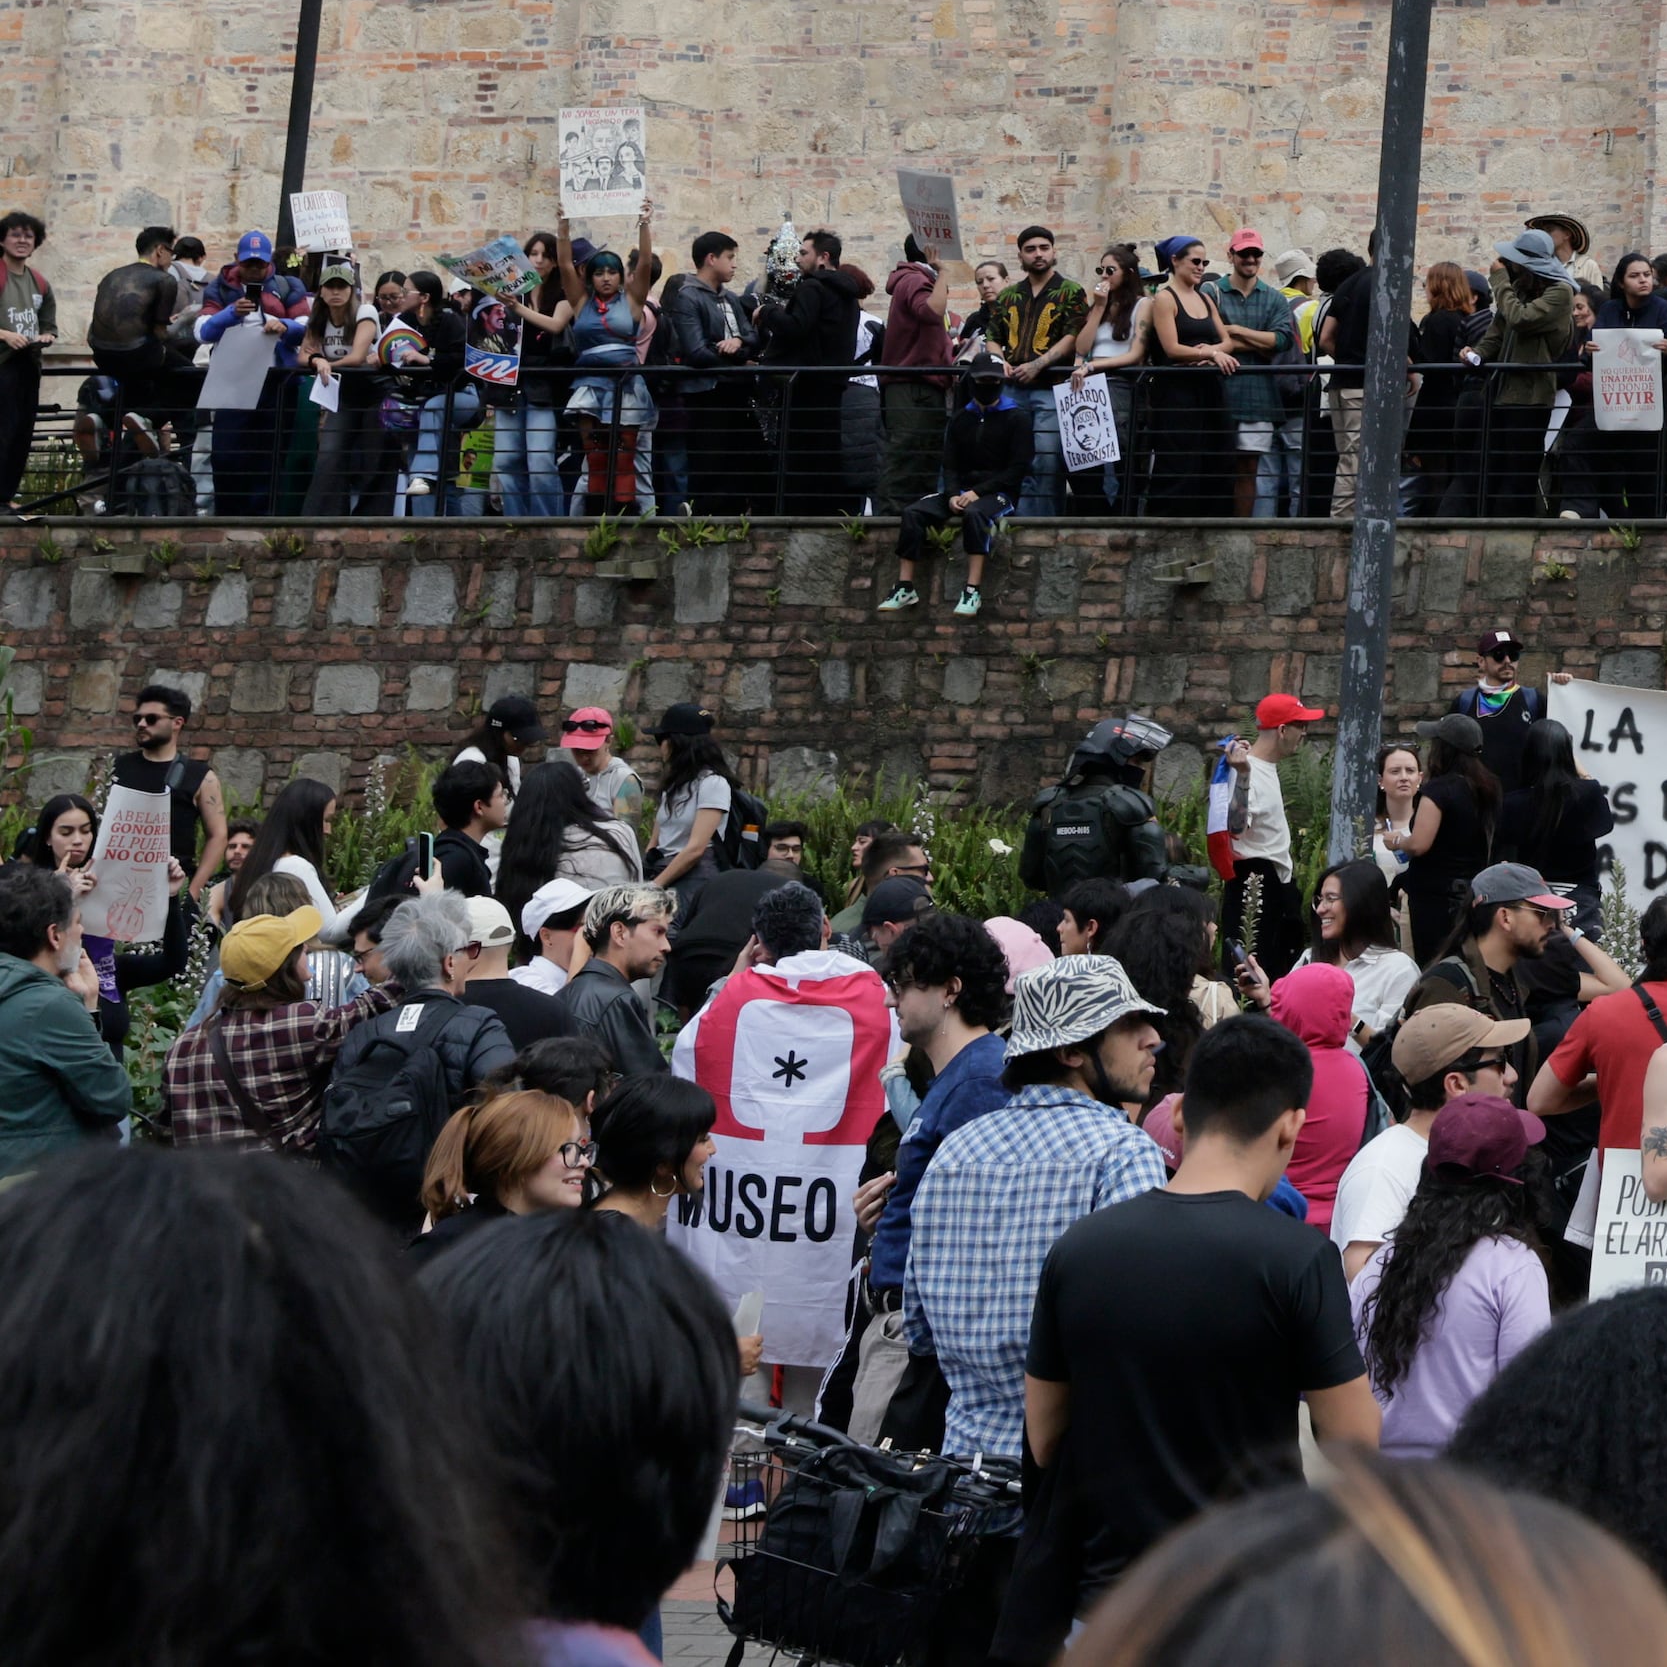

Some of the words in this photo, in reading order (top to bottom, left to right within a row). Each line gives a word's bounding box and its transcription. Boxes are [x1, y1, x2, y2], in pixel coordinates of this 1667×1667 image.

[1601, 383, 1615, 392] EN
[1618, 382, 1655, 391] DONDE
[1060, 389, 1107, 418] ABELARDO
[1602, 392, 1655, 405] VIVIR
[1066, 442, 1116, 467] TERRORISTA
[1580, 706, 1644, 754] LA
[1601, 782, 1638, 825] S
[113, 810, 169, 824] ABELAR
[110, 822, 170, 836] GONORR
[106, 835, 127, 848] EL
[103, 848, 130, 861] NO
[678, 1166, 837, 1243] MUSEO
[1605, 1221, 1631, 1255] EL
